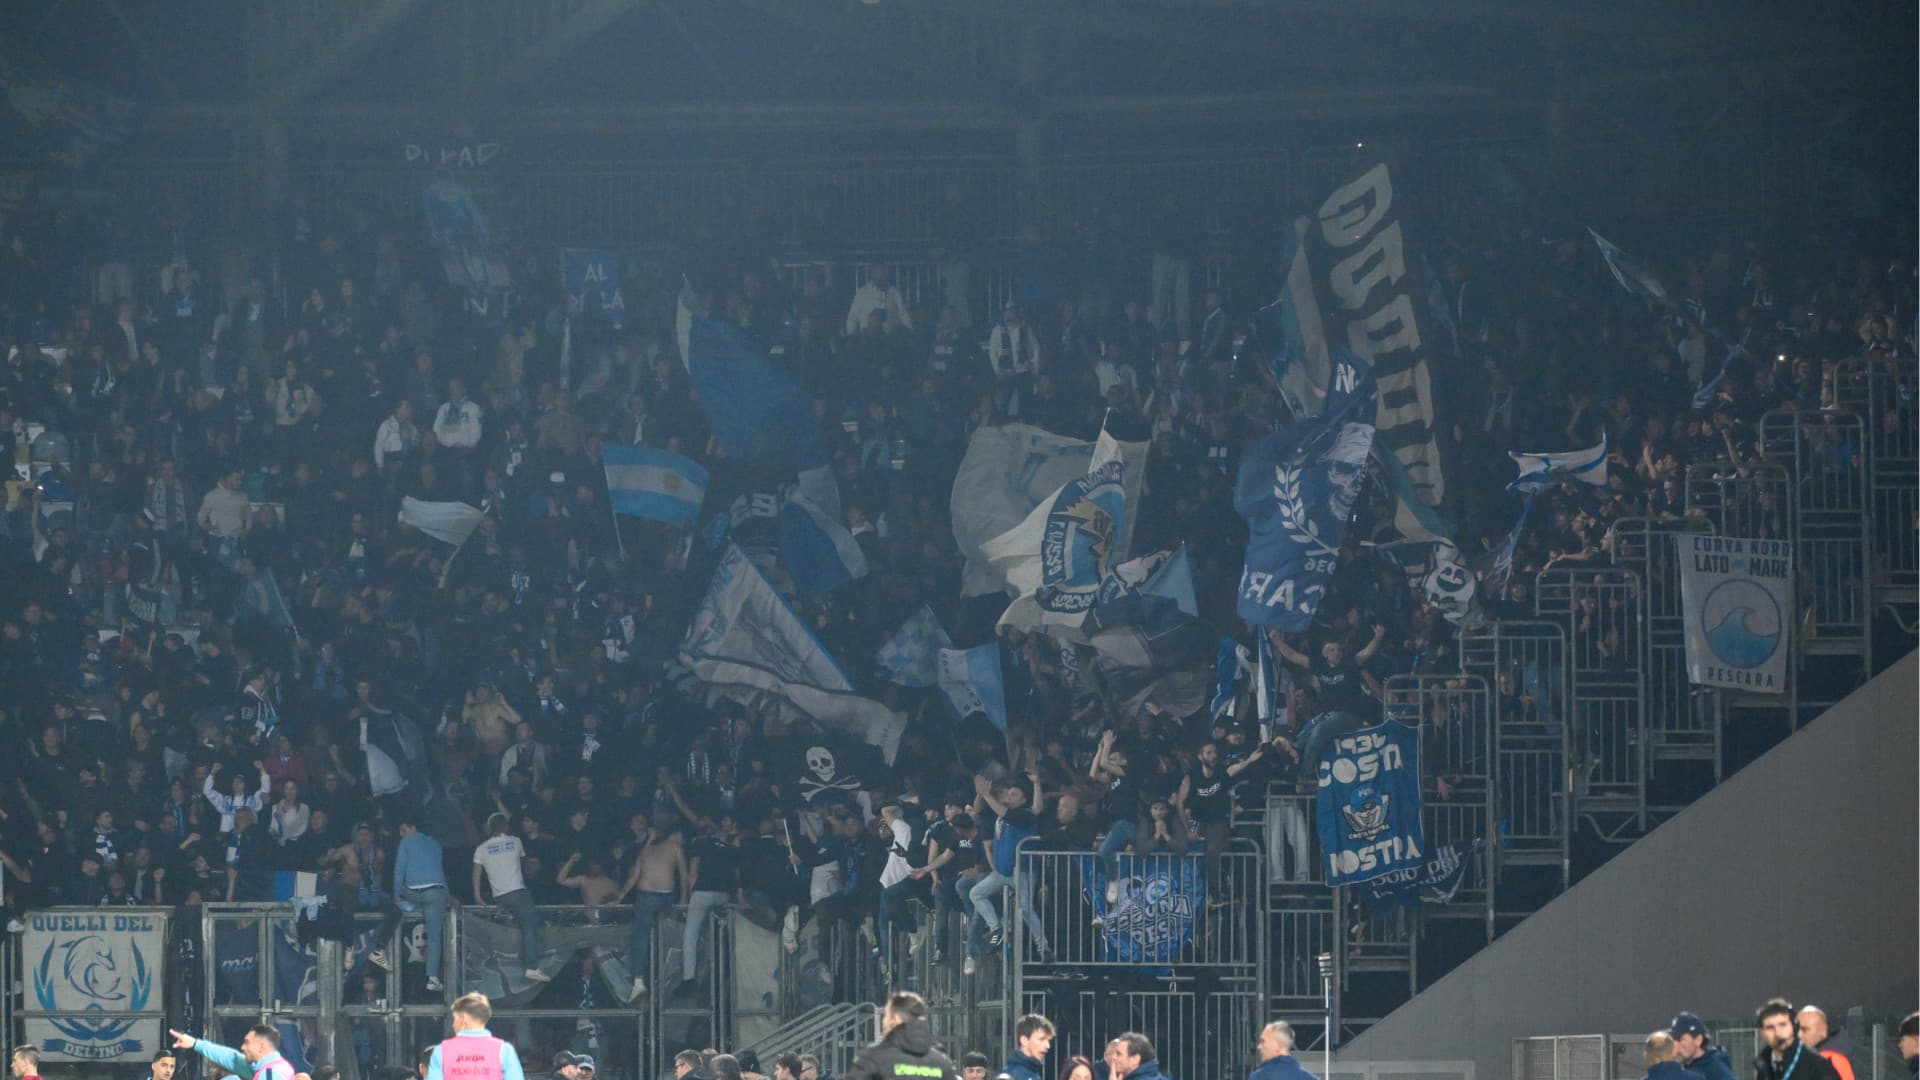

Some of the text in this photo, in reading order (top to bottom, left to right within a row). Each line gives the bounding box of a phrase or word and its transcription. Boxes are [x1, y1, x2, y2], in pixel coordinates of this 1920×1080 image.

[1694, 537, 1790, 558] CURVA NORD
[1695, 554, 1789, 578] LATO MARE
[1708, 667, 1774, 688] PESCARA
[32, 915, 153, 932] QUELLI DEL
